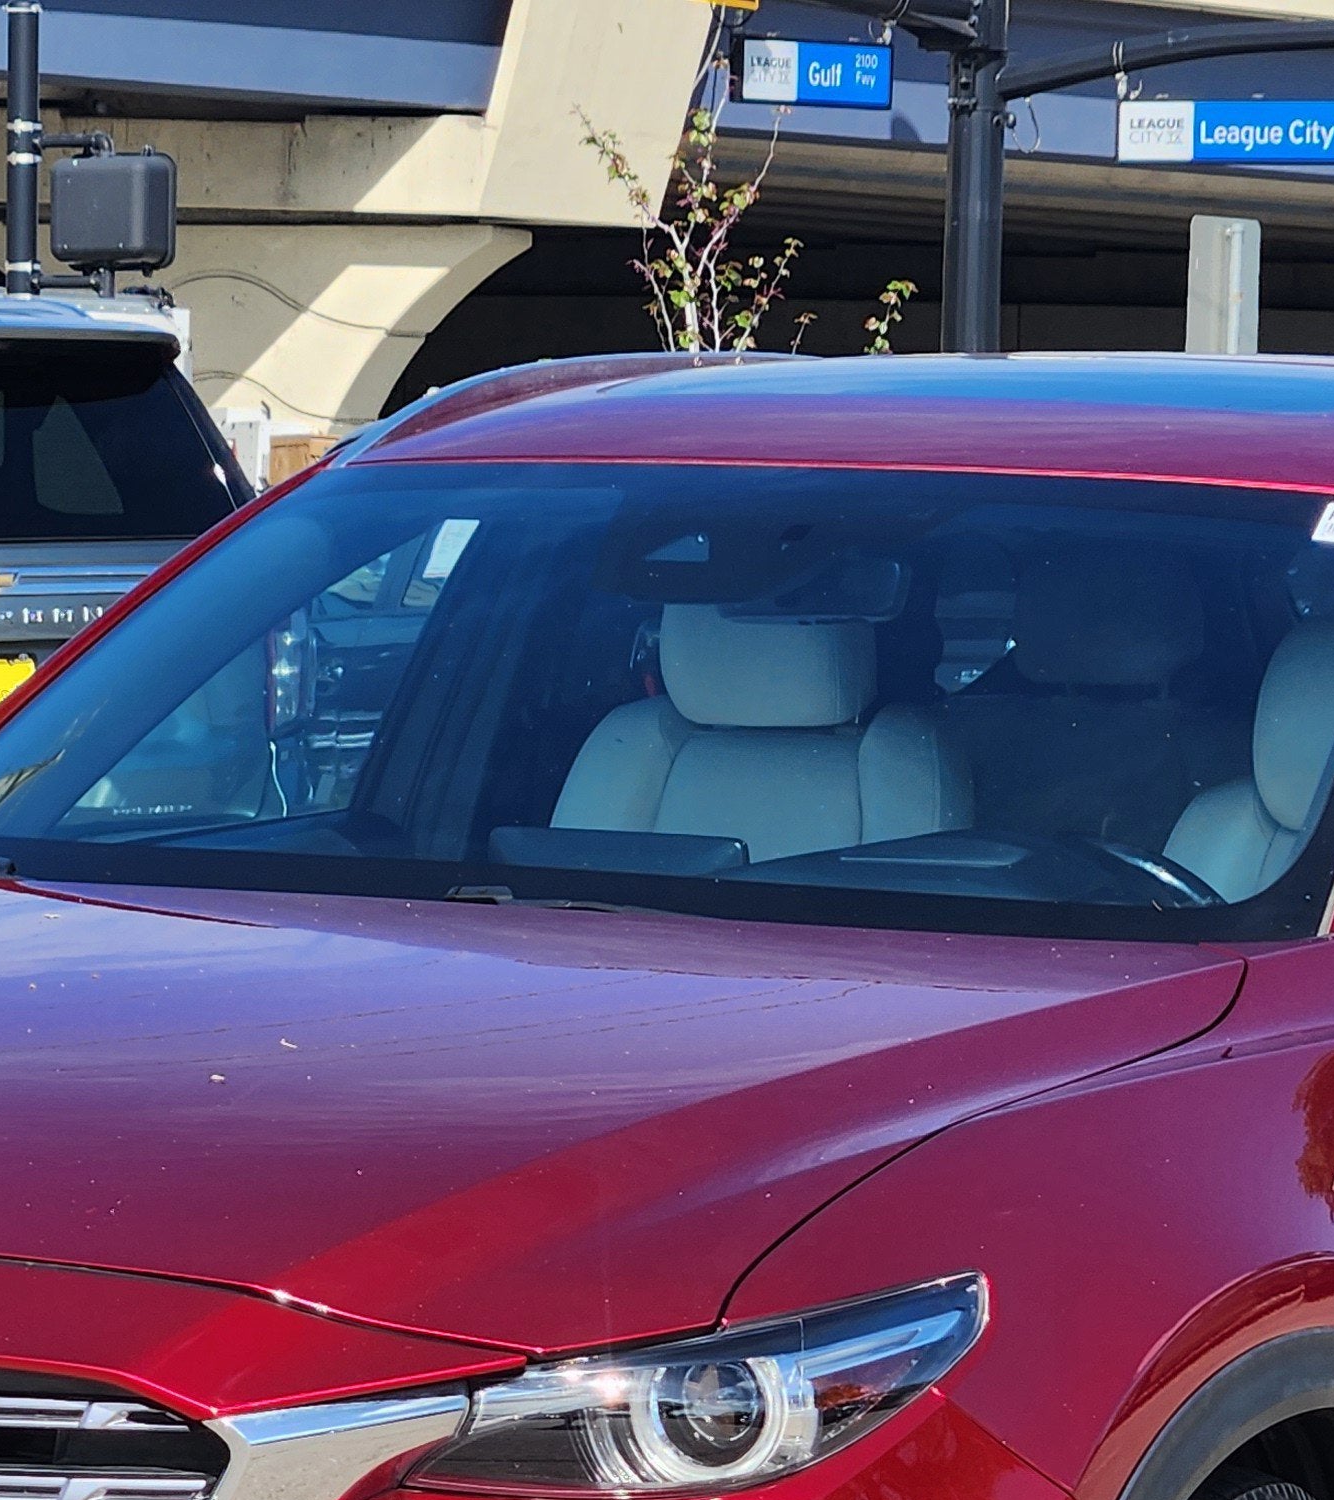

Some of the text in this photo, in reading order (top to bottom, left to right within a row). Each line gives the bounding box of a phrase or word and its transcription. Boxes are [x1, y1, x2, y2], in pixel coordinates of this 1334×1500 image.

[750, 55, 792, 69] LEAGUE
[855, 53, 879, 70] 2100
[808, 61, 843, 88] Gulf
[855, 71, 876, 89] Fwy
[1129, 117, 1185, 130] LEAGUE
[1129, 131, 1164, 145] CITY
[1199, 119, 1284, 152] League
